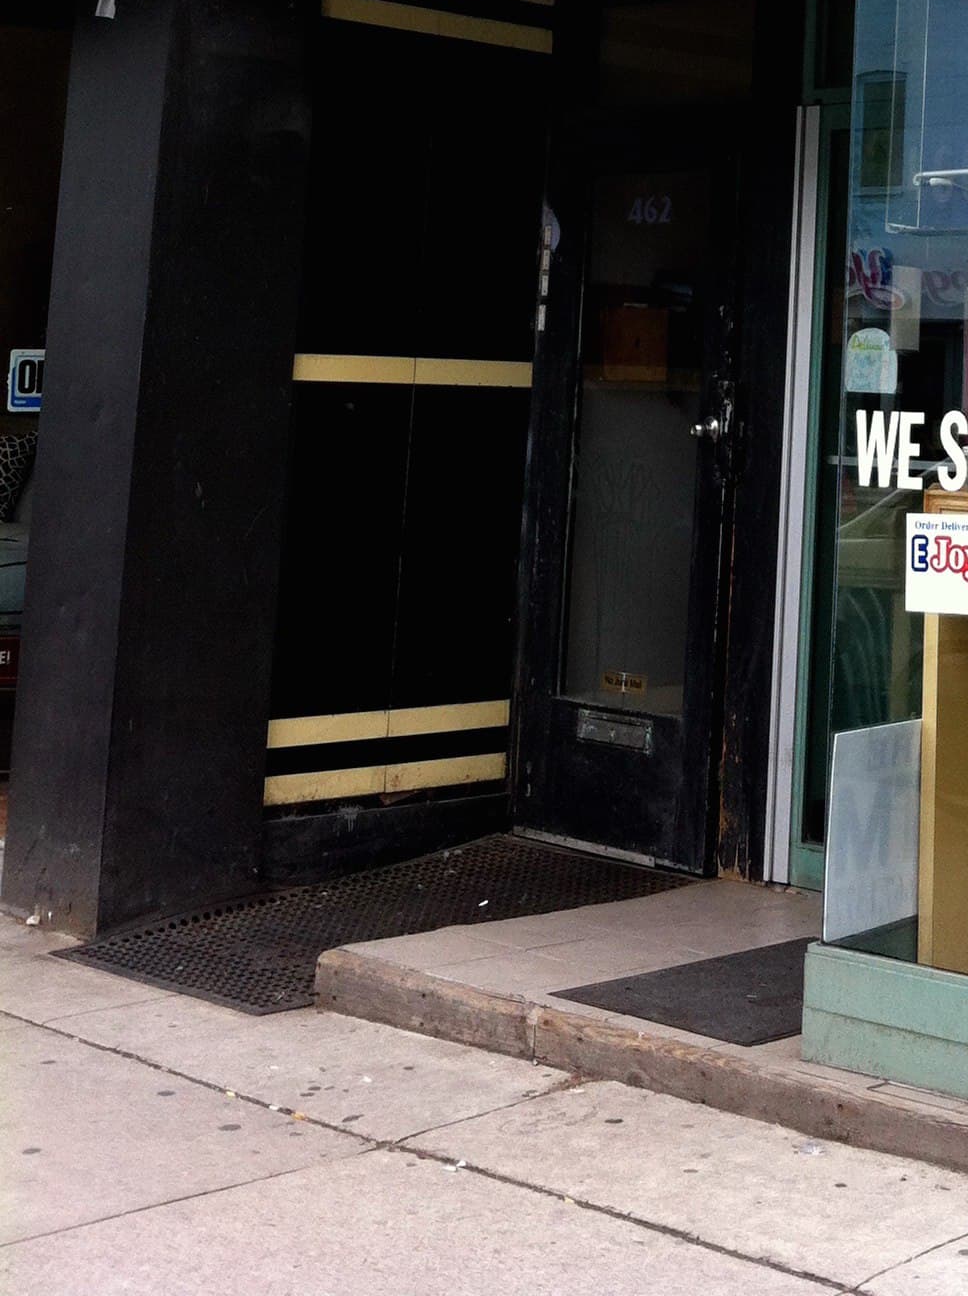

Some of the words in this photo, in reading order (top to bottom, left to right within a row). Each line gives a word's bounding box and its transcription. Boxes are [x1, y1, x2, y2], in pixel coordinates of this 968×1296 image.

[627, 195, 673, 224] 462
[855, 409, 925, 491] WE
[914, 520, 938, 530] Order
